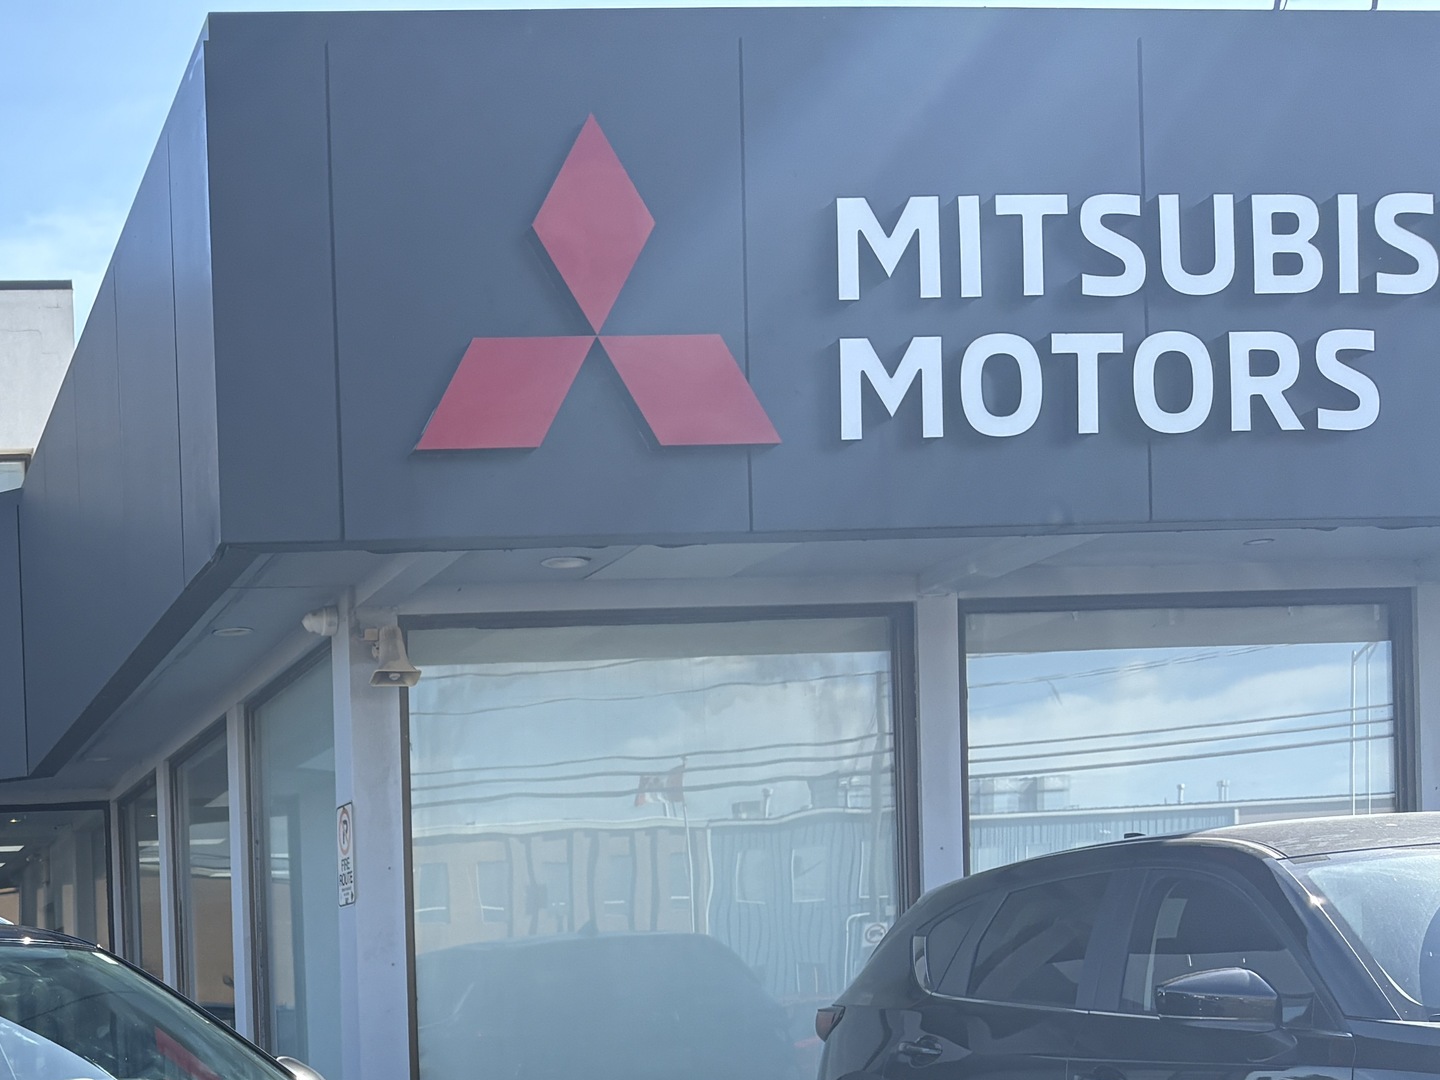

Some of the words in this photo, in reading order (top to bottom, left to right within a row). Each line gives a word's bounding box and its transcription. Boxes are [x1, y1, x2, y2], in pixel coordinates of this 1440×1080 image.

[836, 192, 1440, 300] MITSUBIS
[839, 329, 1382, 441] MOTORS
[339, 871, 353, 886] ROUTE
[341, 857, 350, 872] FIRE
